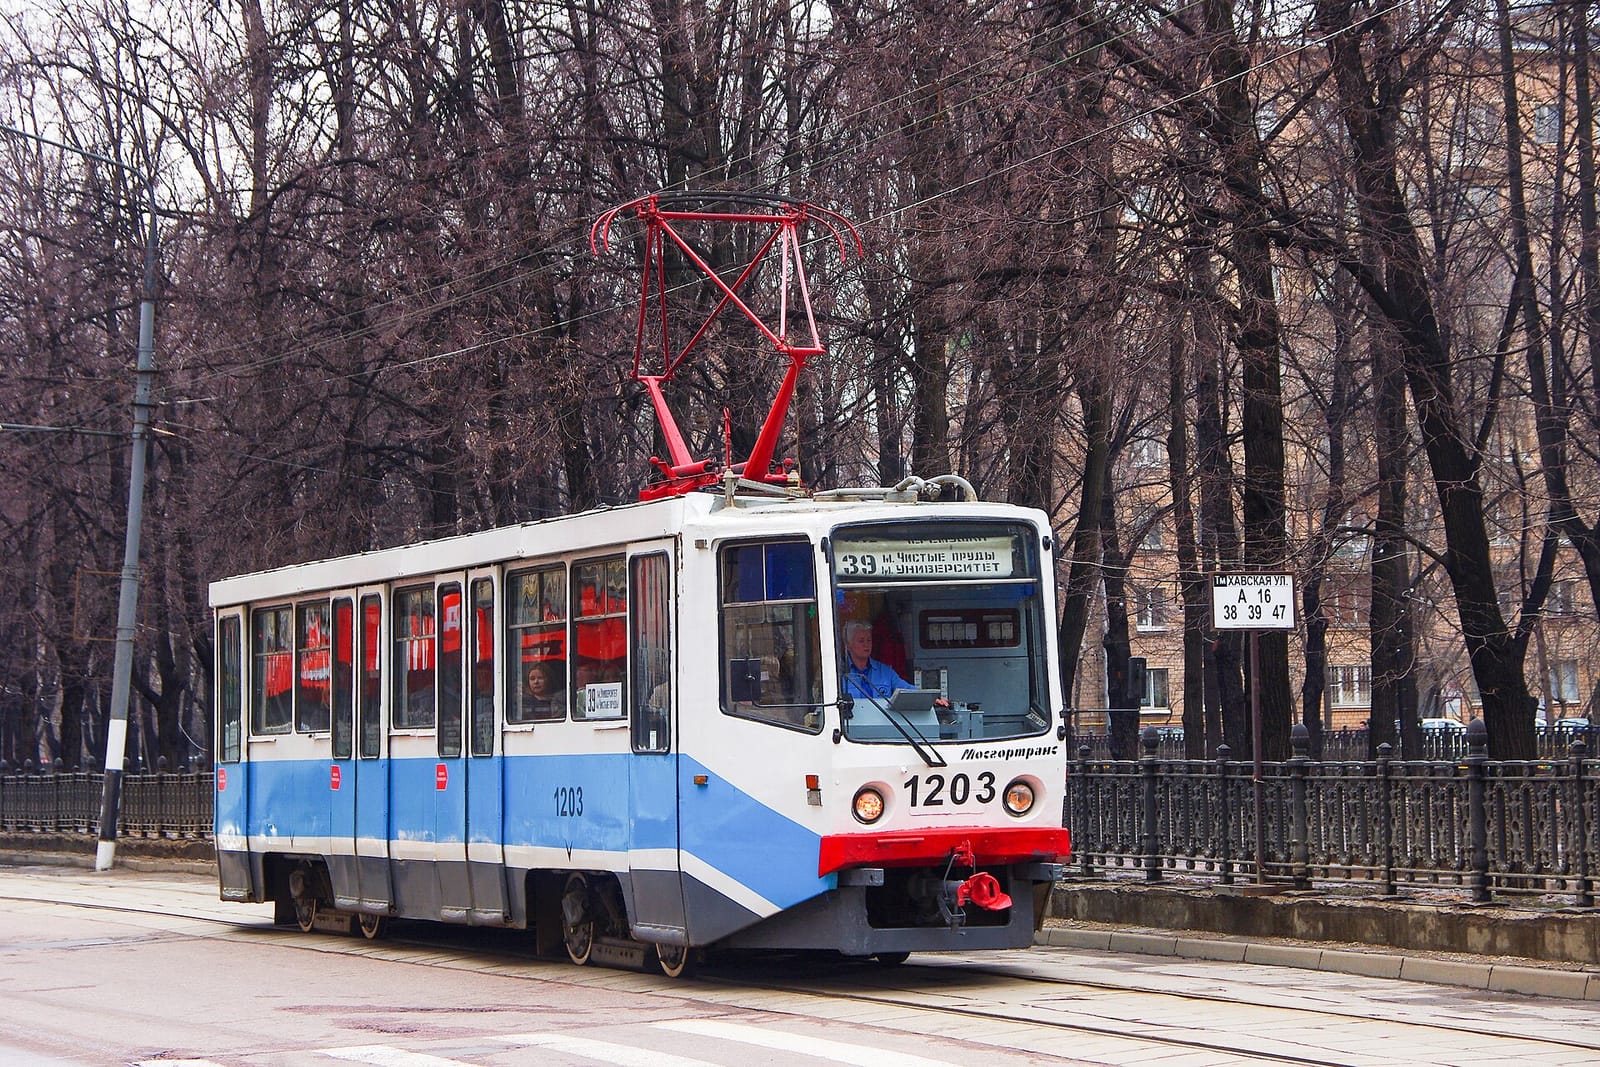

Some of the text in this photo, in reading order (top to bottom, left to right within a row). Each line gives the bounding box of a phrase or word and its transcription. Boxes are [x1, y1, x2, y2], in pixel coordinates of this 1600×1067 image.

[842, 554, 877, 575] 39
[897, 552, 946, 563] ЧИСТЫЕ
[952, 552, 996, 562] ПРУДЫ
[896, 563, 1001, 574] УНИВЕРСИТЕТ
[1228, 575, 1272, 586] ХАВСКАЯ
[1273, 575, 1289, 586] УЛ.
[1237, 588, 1272, 604] А 16
[1223, 604, 1286, 620] 38 39 47
[587, 688, 596, 712] 39
[961, 745, 1059, 761] Мосгортранс
[903, 771, 997, 808] 1203
[553, 786, 584, 817] 1203
